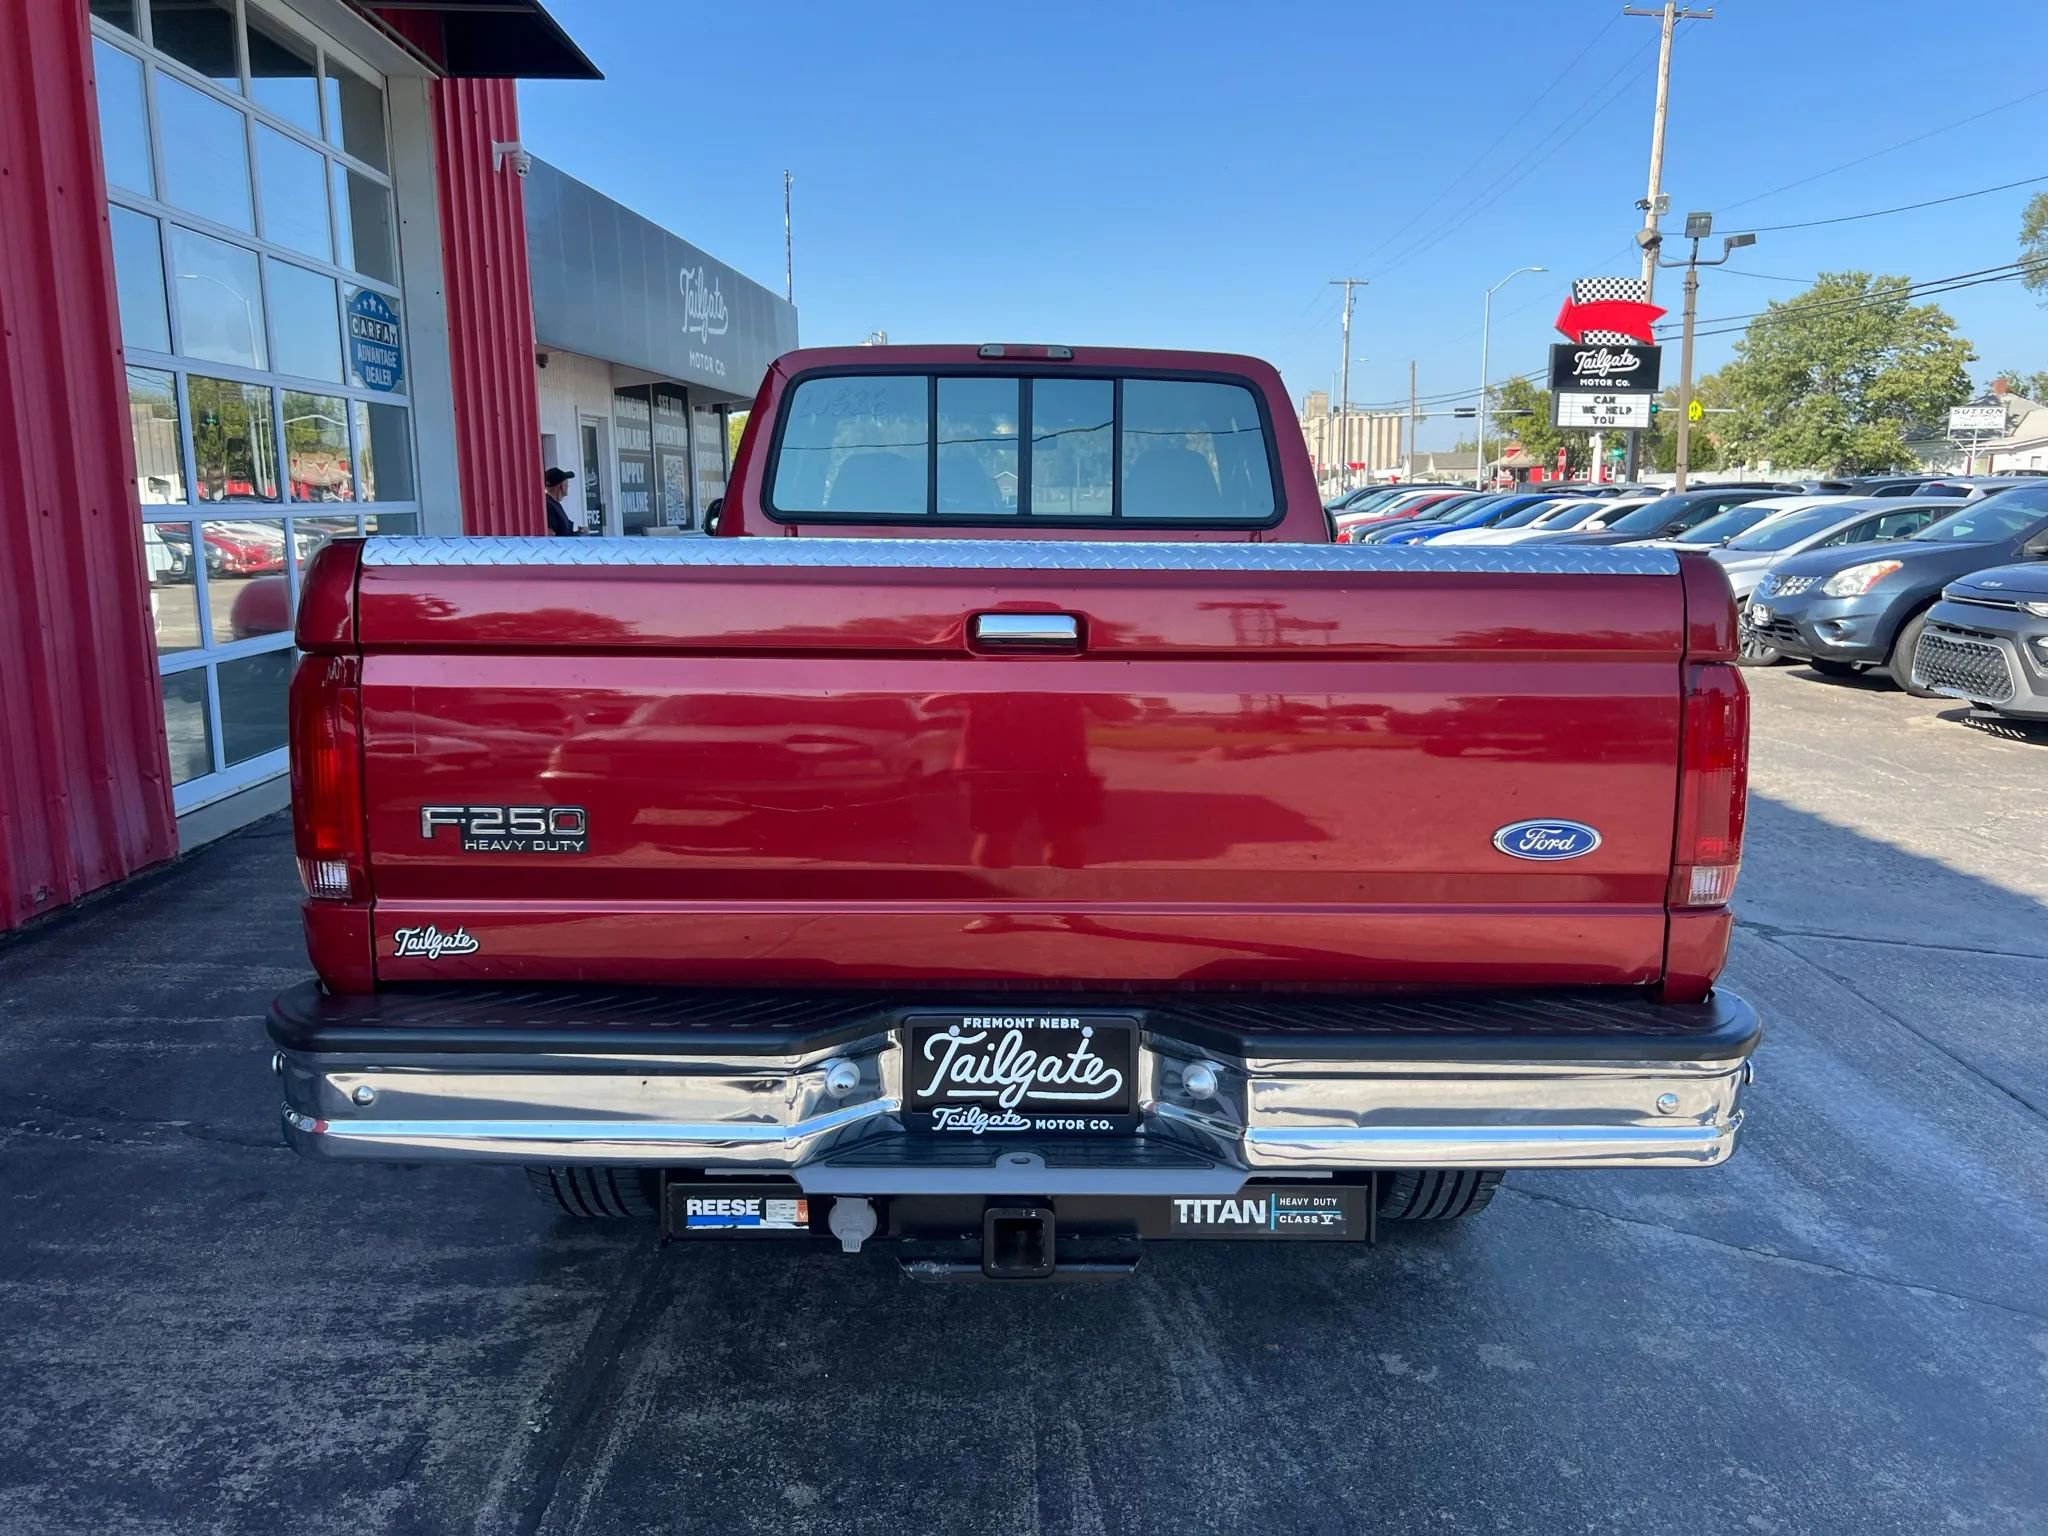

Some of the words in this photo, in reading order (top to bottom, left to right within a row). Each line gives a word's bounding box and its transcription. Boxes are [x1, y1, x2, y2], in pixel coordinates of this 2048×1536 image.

[680, 266, 728, 344] Tailgate
[352, 318, 398, 346] CARFAX
[357, 343, 397, 367] ADVANTAGE
[689, 350, 713, 373] MOTOR
[1572, 348, 1640, 377] Tailgate
[365, 366, 392, 386] DEALER
[1580, 379, 1613, 387] MOTOR
[657, 394, 670, 416] SEE
[1582, 406, 1597, 414] WE
[1605, 406, 1632, 415] HELP
[1593, 396, 1616, 404] CAN
[1592, 416, 1615, 424] YOU
[621, 462, 645, 484] APPLY
[622, 491, 649, 513] ONLINE
[586, 510, 600, 525] FFICE
[421, 807, 586, 838] F-250
[465, 840, 526, 850] HEAVY
[533, 840, 584, 851] DUTY
[1519, 828, 1577, 850] Ford
[394, 926, 479, 960] Tailgate
[963, 1018, 1034, 1029] FREMONT
[1040, 1018, 1080, 1029] NEBR
[917, 1029, 1123, 1108] Tailgate
[932, 1107, 1031, 1134] Tailgate
[1036, 1119, 1085, 1130] MOTOR
[1090, 1119, 1114, 1130] CO.
[686, 1199, 761, 1216] REESE
[1174, 1199, 1266, 1224] TITAN
[1279, 1198, 1309, 1206] HEAVY
[1313, 1198, 1338, 1206] DUTY
[1279, 1215, 1319, 1223] CLASS
[1320, 1215, 1334, 1225] V
